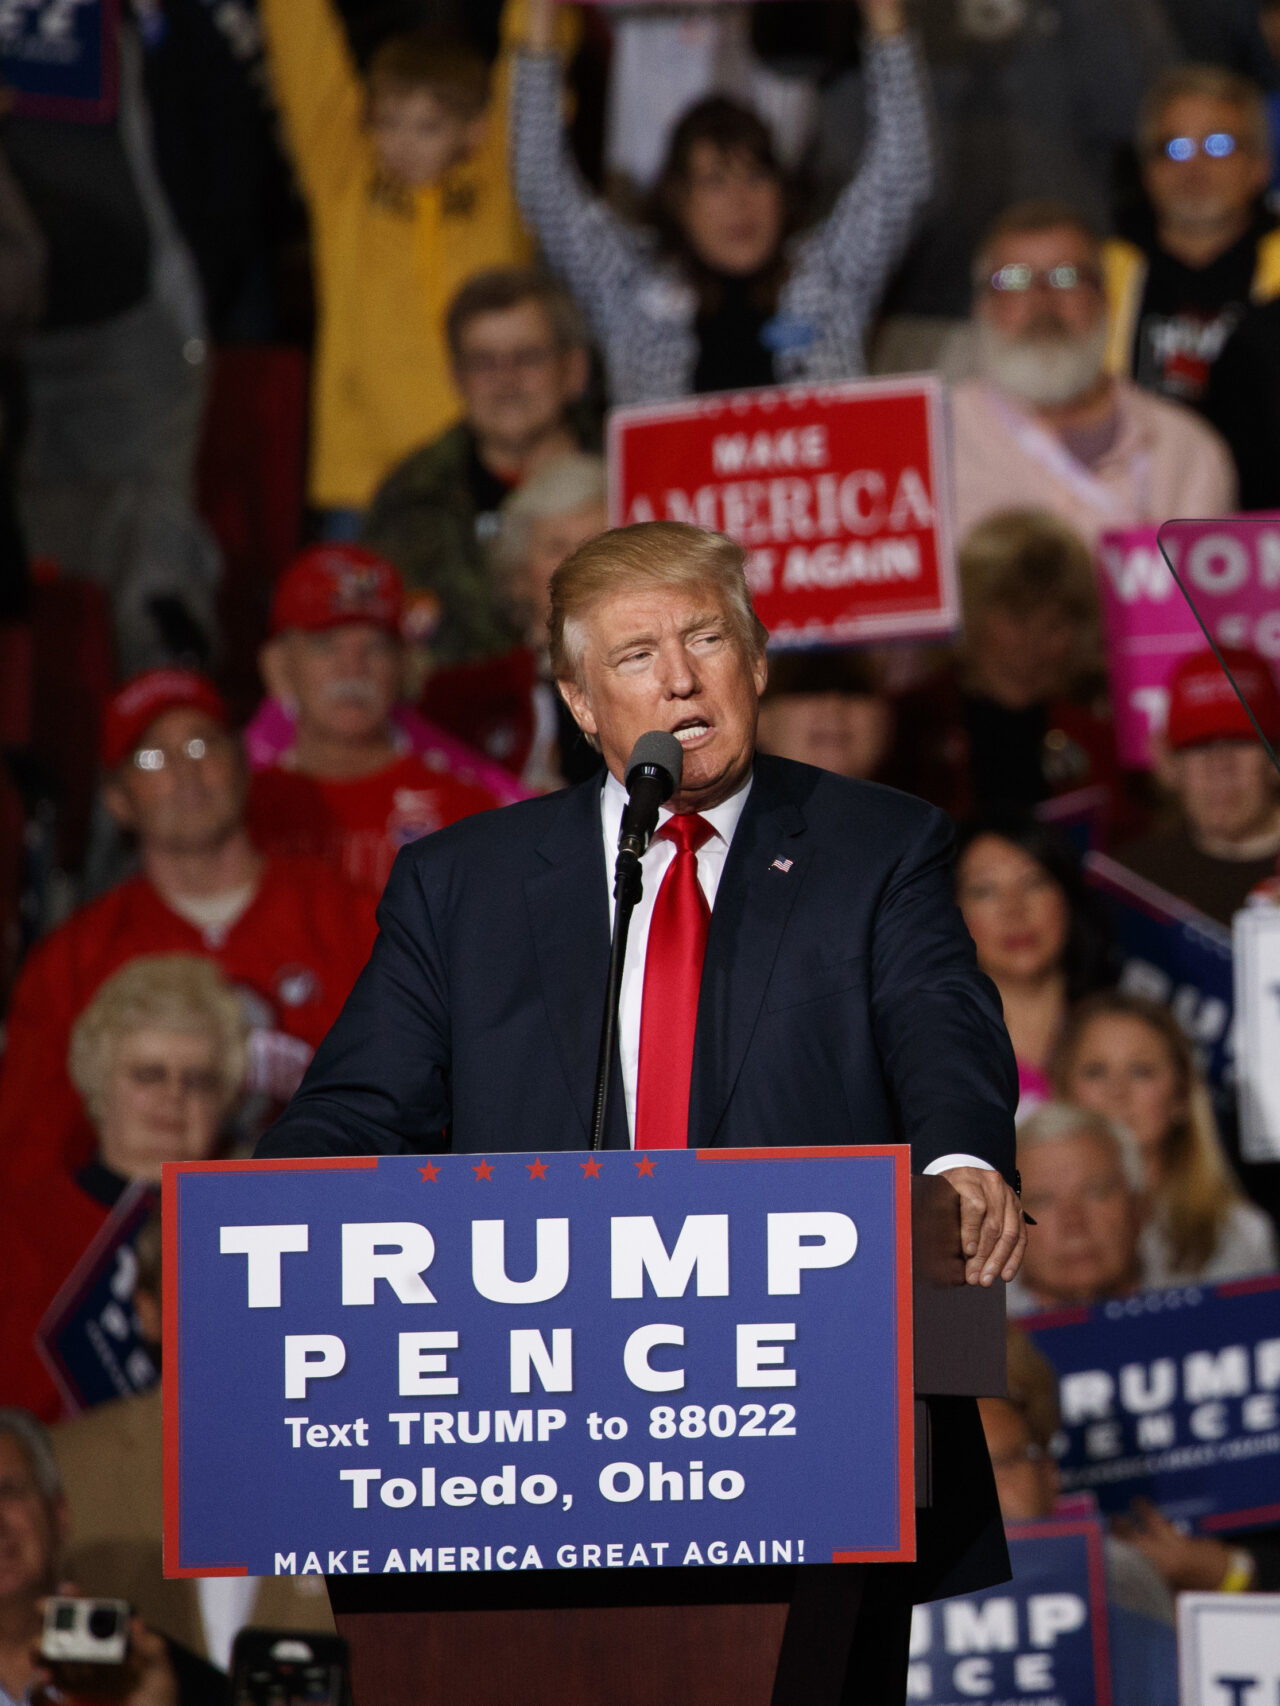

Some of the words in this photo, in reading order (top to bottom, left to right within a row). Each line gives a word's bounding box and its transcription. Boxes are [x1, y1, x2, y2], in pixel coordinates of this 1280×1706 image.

[712, 424, 827, 476] MAKE
[781, 535, 923, 594] AGAIN
[219, 1211, 860, 1309] TRUMP
[284, 1323, 797, 1399] PENCE
[284, 1416, 368, 1448] Text
[389, 1408, 567, 1445] TRUMP
[587, 1412, 628, 1441] to
[648, 1403, 797, 1440] 88022
[340, 1464, 574, 1512] Toledo,
[599, 1461, 746, 1502] Ohio
[274, 1551, 370, 1576] MAKE
[383, 1545, 537, 1573] AMERICA
[556, 1541, 673, 1568] GREAT
[683, 1539, 806, 1566] AGAIN!
[906, 1653, 1056, 1699] NCE
